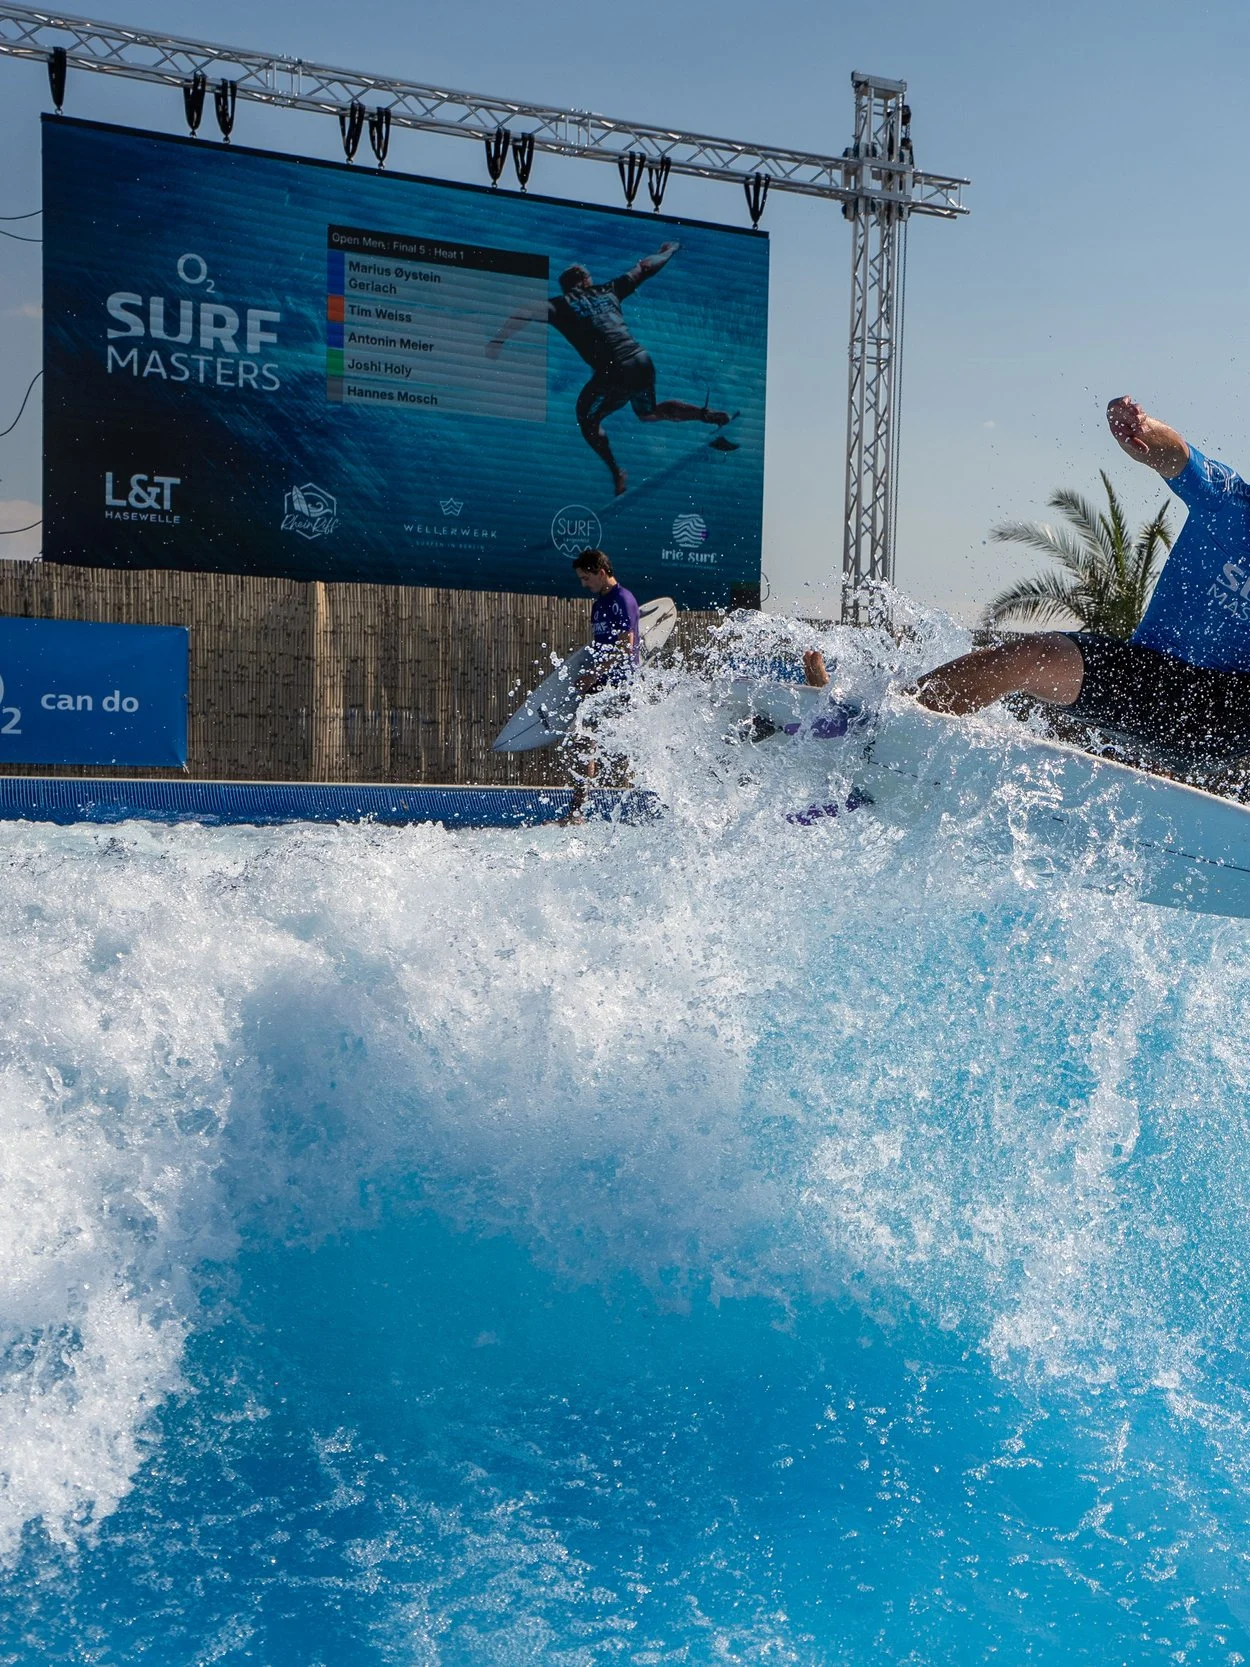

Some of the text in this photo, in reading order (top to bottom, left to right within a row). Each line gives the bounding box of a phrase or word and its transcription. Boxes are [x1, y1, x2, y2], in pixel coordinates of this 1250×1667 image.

[332, 233, 359, 248] Open
[362, 237, 383, 248] Men
[393, 242, 417, 253] Final
[419, 245, 425, 254] 5
[434, 248, 457, 259] Heat
[349, 261, 441, 284] Marius Øystein
[348, 278, 397, 295] Gerlach
[106, 292, 281, 353] SURF
[348, 305, 412, 323] Tim Weiss
[348, 332, 434, 353] Antonin Meier
[107, 345, 281, 392] MASTERS
[347, 359, 412, 377] Joshi Holy
[347, 385, 438, 406] Hannes Mosch
[105, 471, 181, 511] L&T
[104, 511, 181, 524] HASEWELLE
[557, 517, 596, 537] SURF
[403, 523, 497, 539] WELLERWERK
[40, 693, 93, 711] can
[102, 690, 139, 713] do
